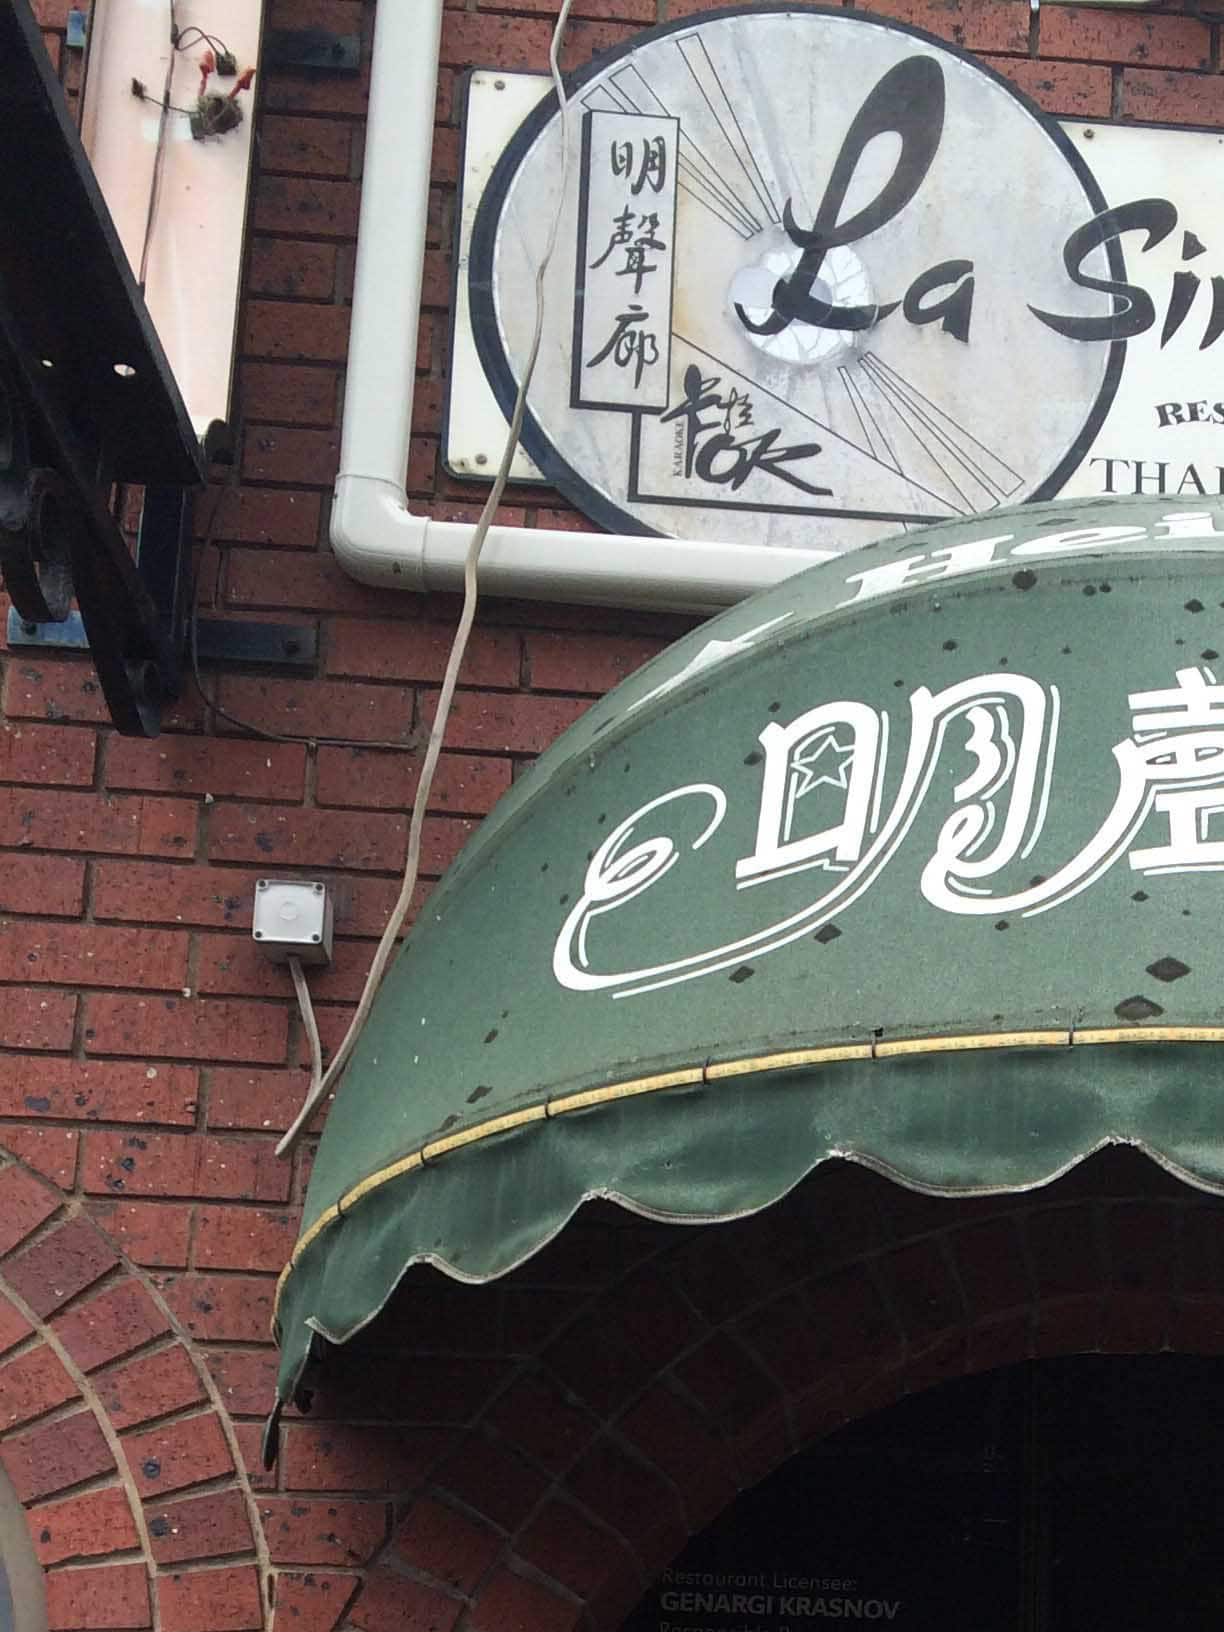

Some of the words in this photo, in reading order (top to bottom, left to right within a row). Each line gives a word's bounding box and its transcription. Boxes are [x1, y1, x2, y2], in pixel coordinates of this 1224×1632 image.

[588, 134, 667, 389] 明聲廊
[734, 54, 976, 344] La
[779, 1597, 901, 1620] KRASNOV
